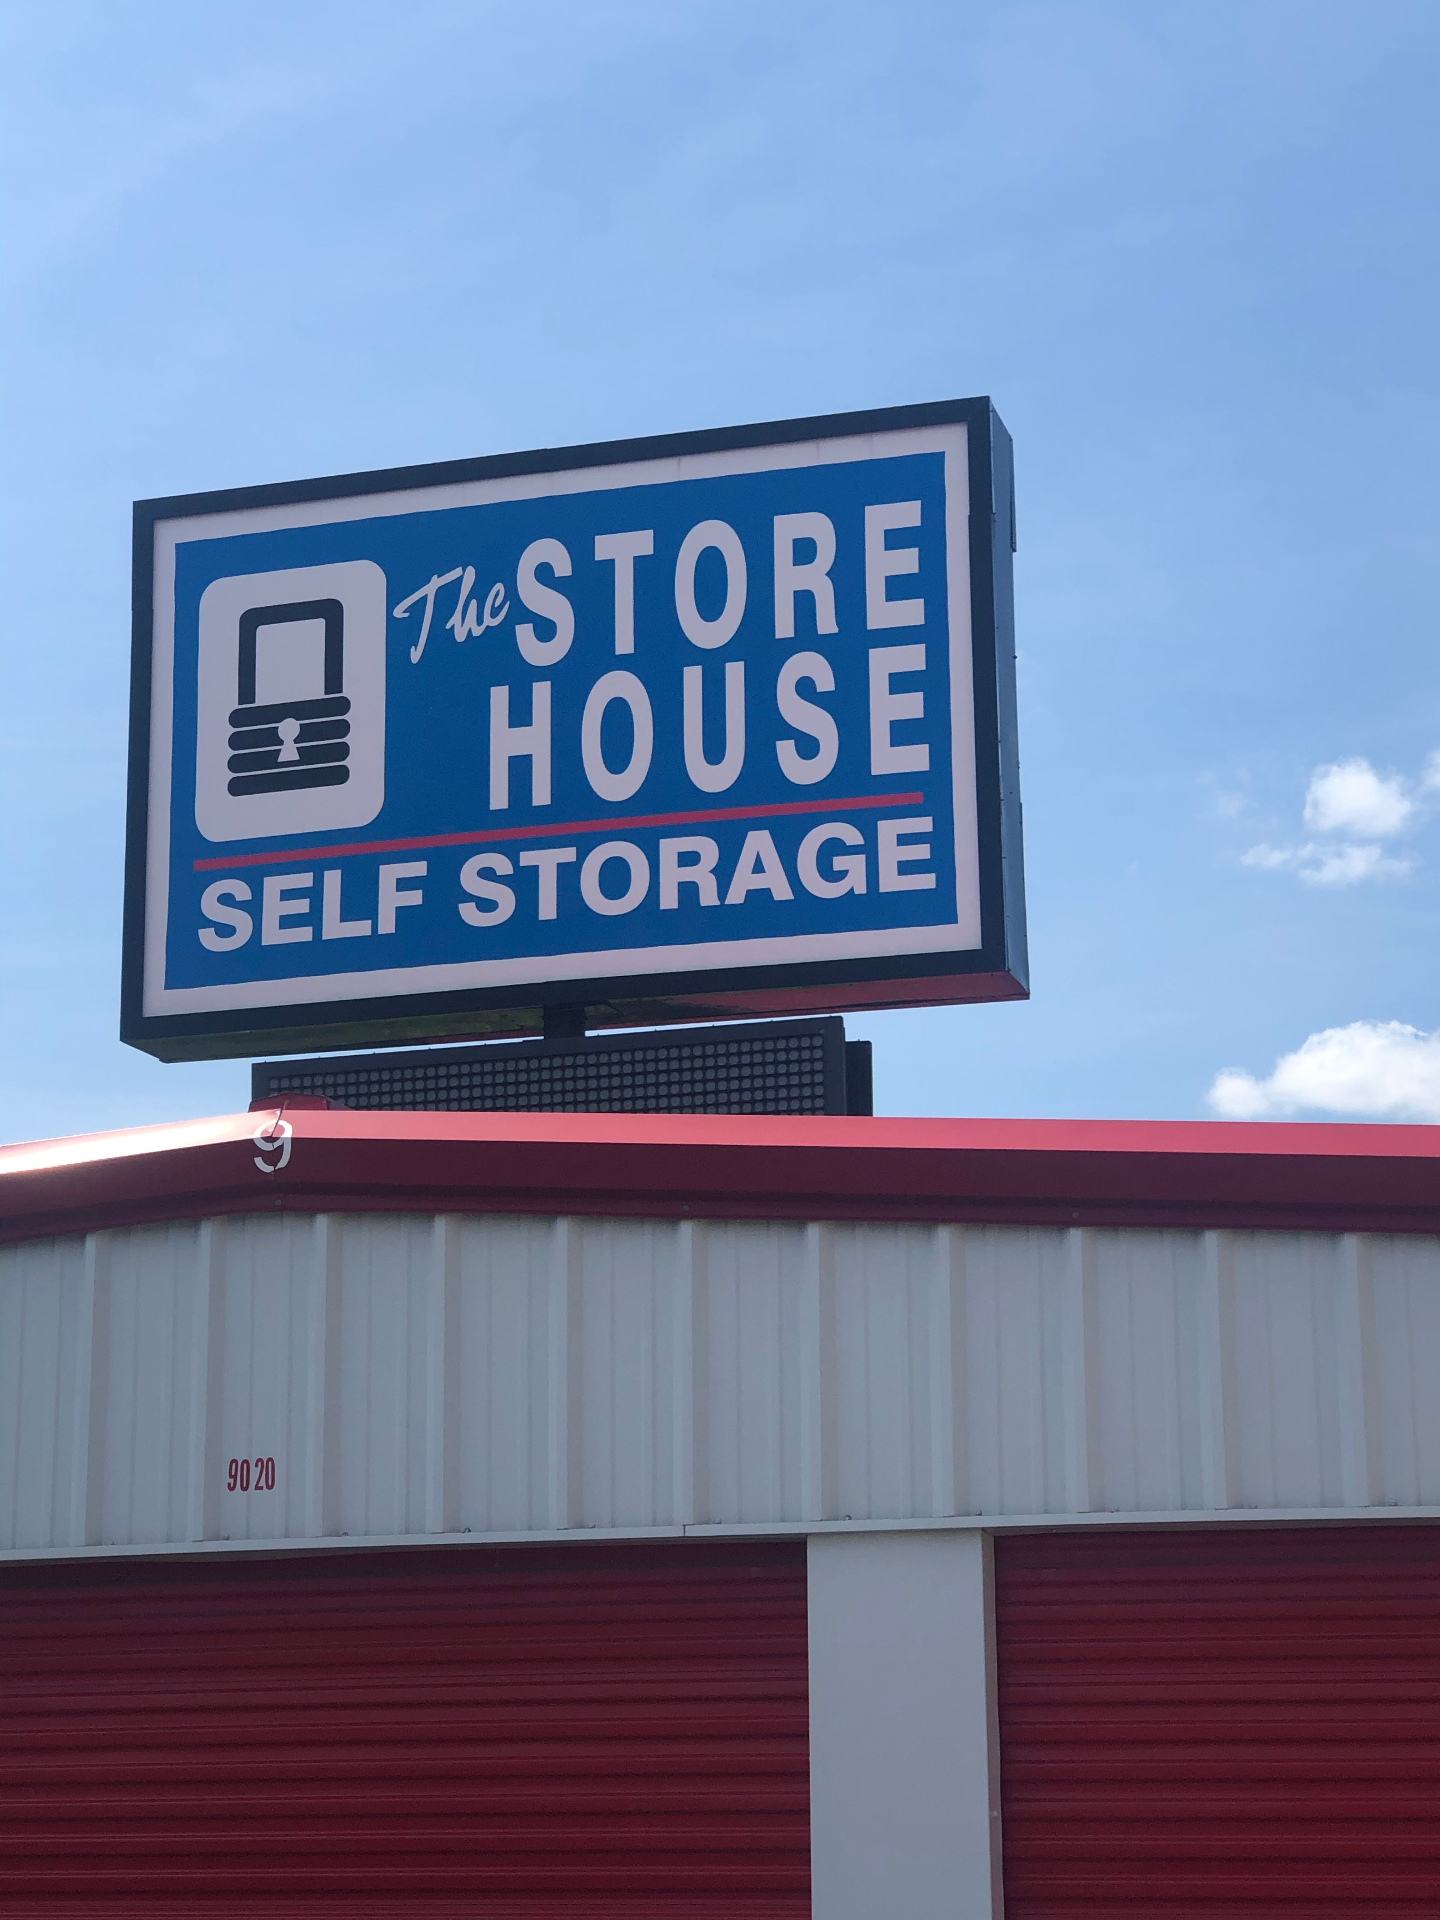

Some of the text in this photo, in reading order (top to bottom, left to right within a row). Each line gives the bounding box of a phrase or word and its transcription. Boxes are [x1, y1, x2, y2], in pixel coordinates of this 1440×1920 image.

[393, 499, 925, 666] The STORE
[489, 643, 931, 811] HOUSE
[198, 816, 937, 952] SELF STORAGE
[253, 1119, 293, 1173] 9
